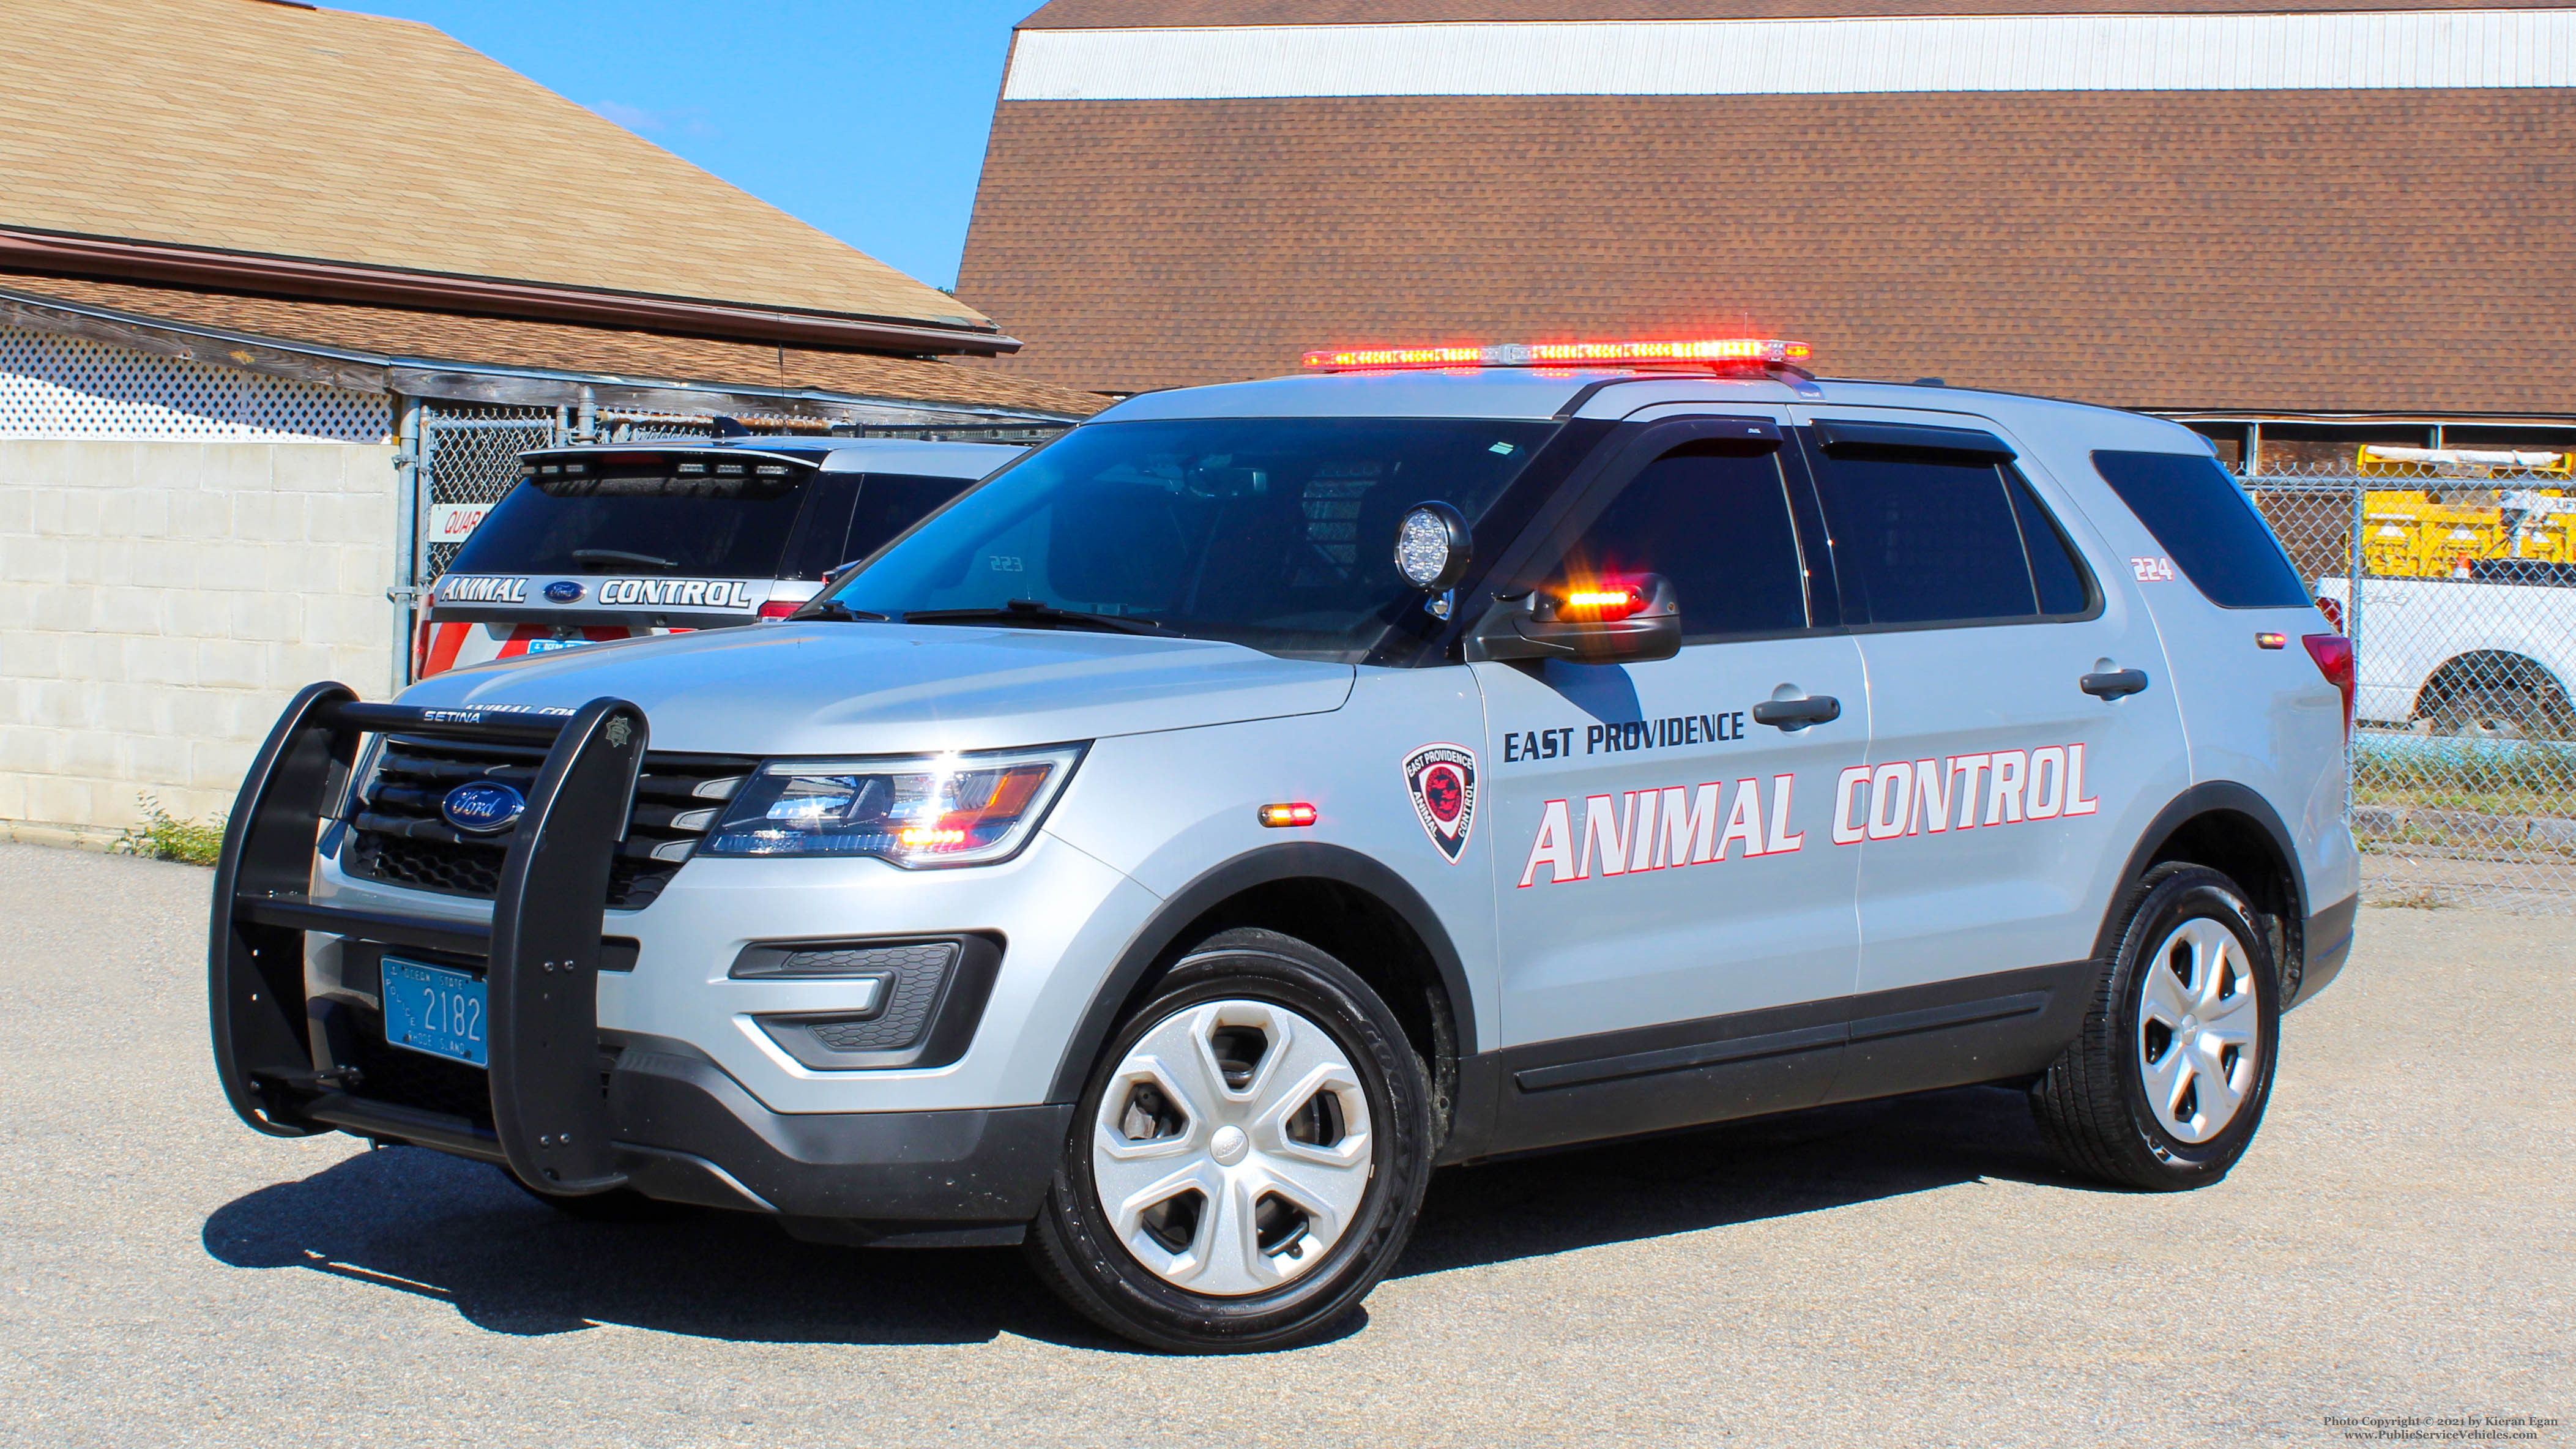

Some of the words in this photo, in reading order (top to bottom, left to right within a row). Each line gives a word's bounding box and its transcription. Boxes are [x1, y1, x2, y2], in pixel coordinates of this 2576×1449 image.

[445, 511, 489, 534] QUAR
[989, 556, 1022, 572] 223
[2130, 557, 2173, 582] 224
[439, 576, 530, 603] ANIMAL
[598, 579, 752, 609] CONTROL
[424, 710, 481, 723] SETINA
[1503, 728, 1574, 763] EAST
[1587, 712, 1744, 754] PROVIDENCE
[1407, 756, 1424, 778] EAST
[1424, 749, 1473, 770] PROVIDENCE
[453, 789, 501, 818] Ford
[1413, 791, 1439, 837] ANIMAL
[1457, 782, 1473, 838] CONTROL
[1517, 773, 1804, 888] ANIMAL
[1832, 743, 2098, 845] CONTROL
[439, 975, 463, 990] STATE
[423, 988, 480, 1041] 2182
